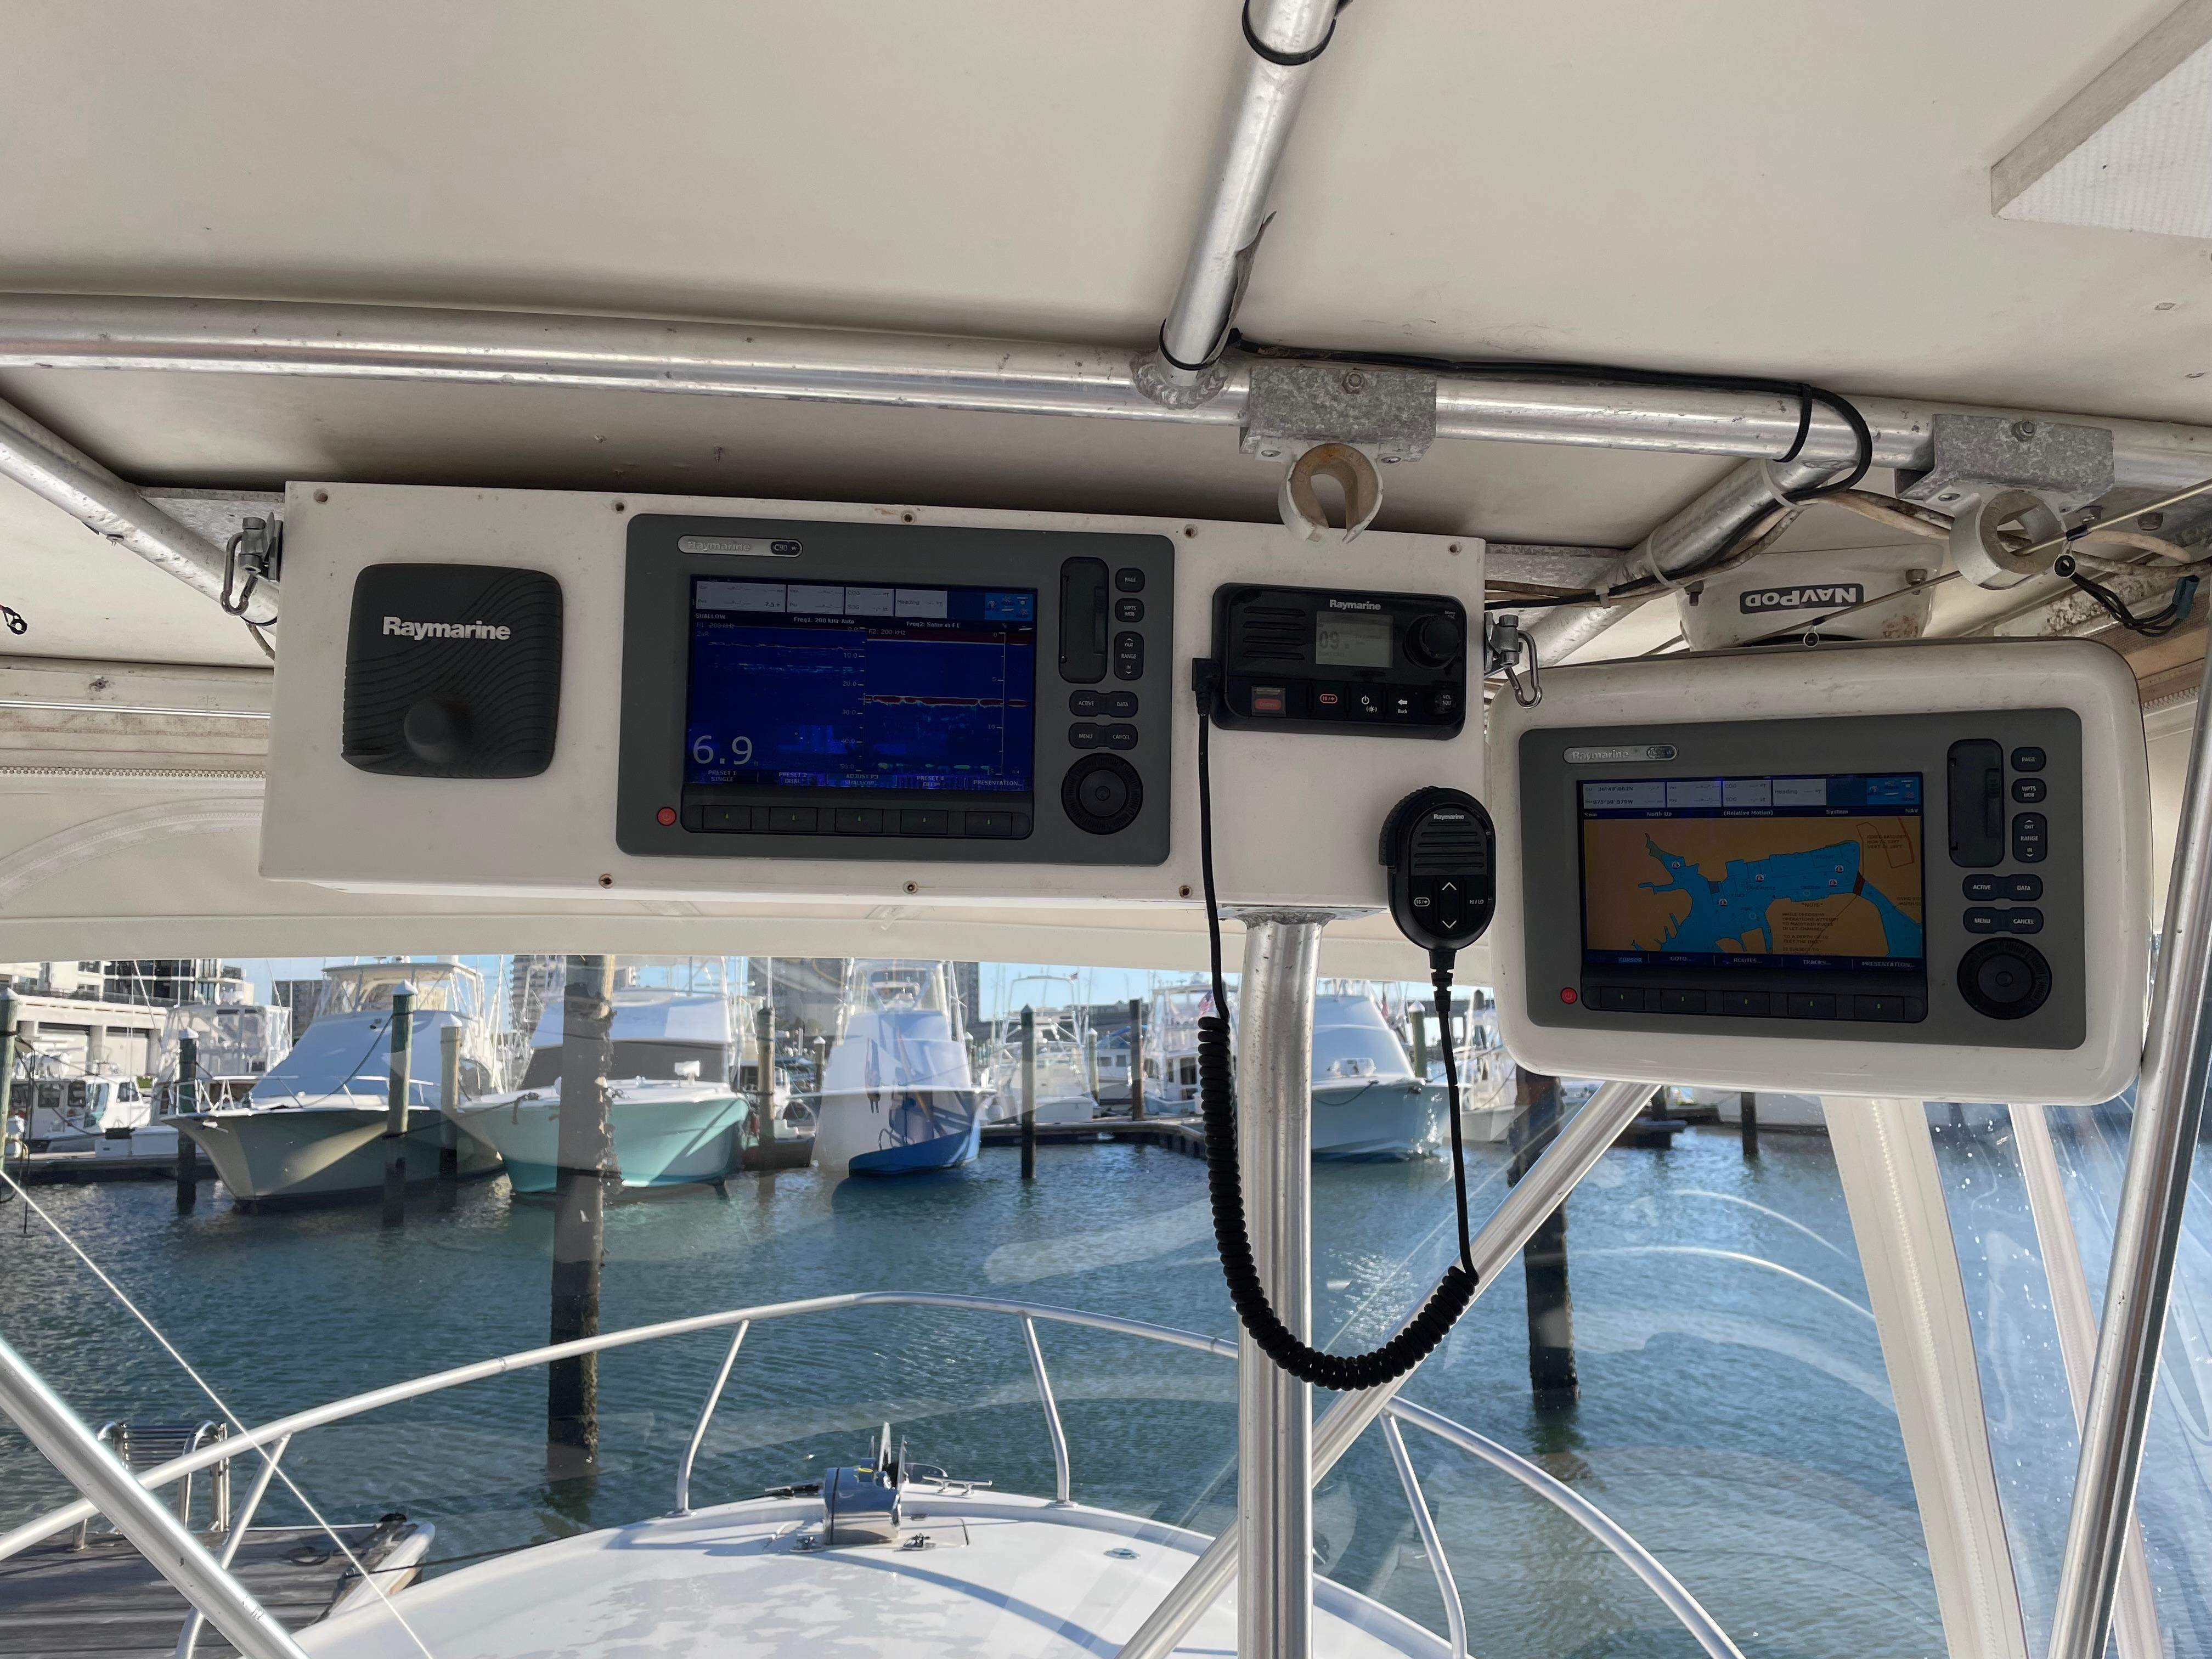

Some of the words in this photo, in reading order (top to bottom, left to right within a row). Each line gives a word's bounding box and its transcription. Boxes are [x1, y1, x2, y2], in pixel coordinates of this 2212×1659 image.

[687, 540, 751, 552] Raymarine
[1329, 599, 1381, 611] Raymarine
[1745, 588, 1857, 607] NAVPOD
[382, 616, 511, 640] Raymarine
[693, 735, 753, 765] 6.9
[1571, 749, 1629, 761] Raymarine
